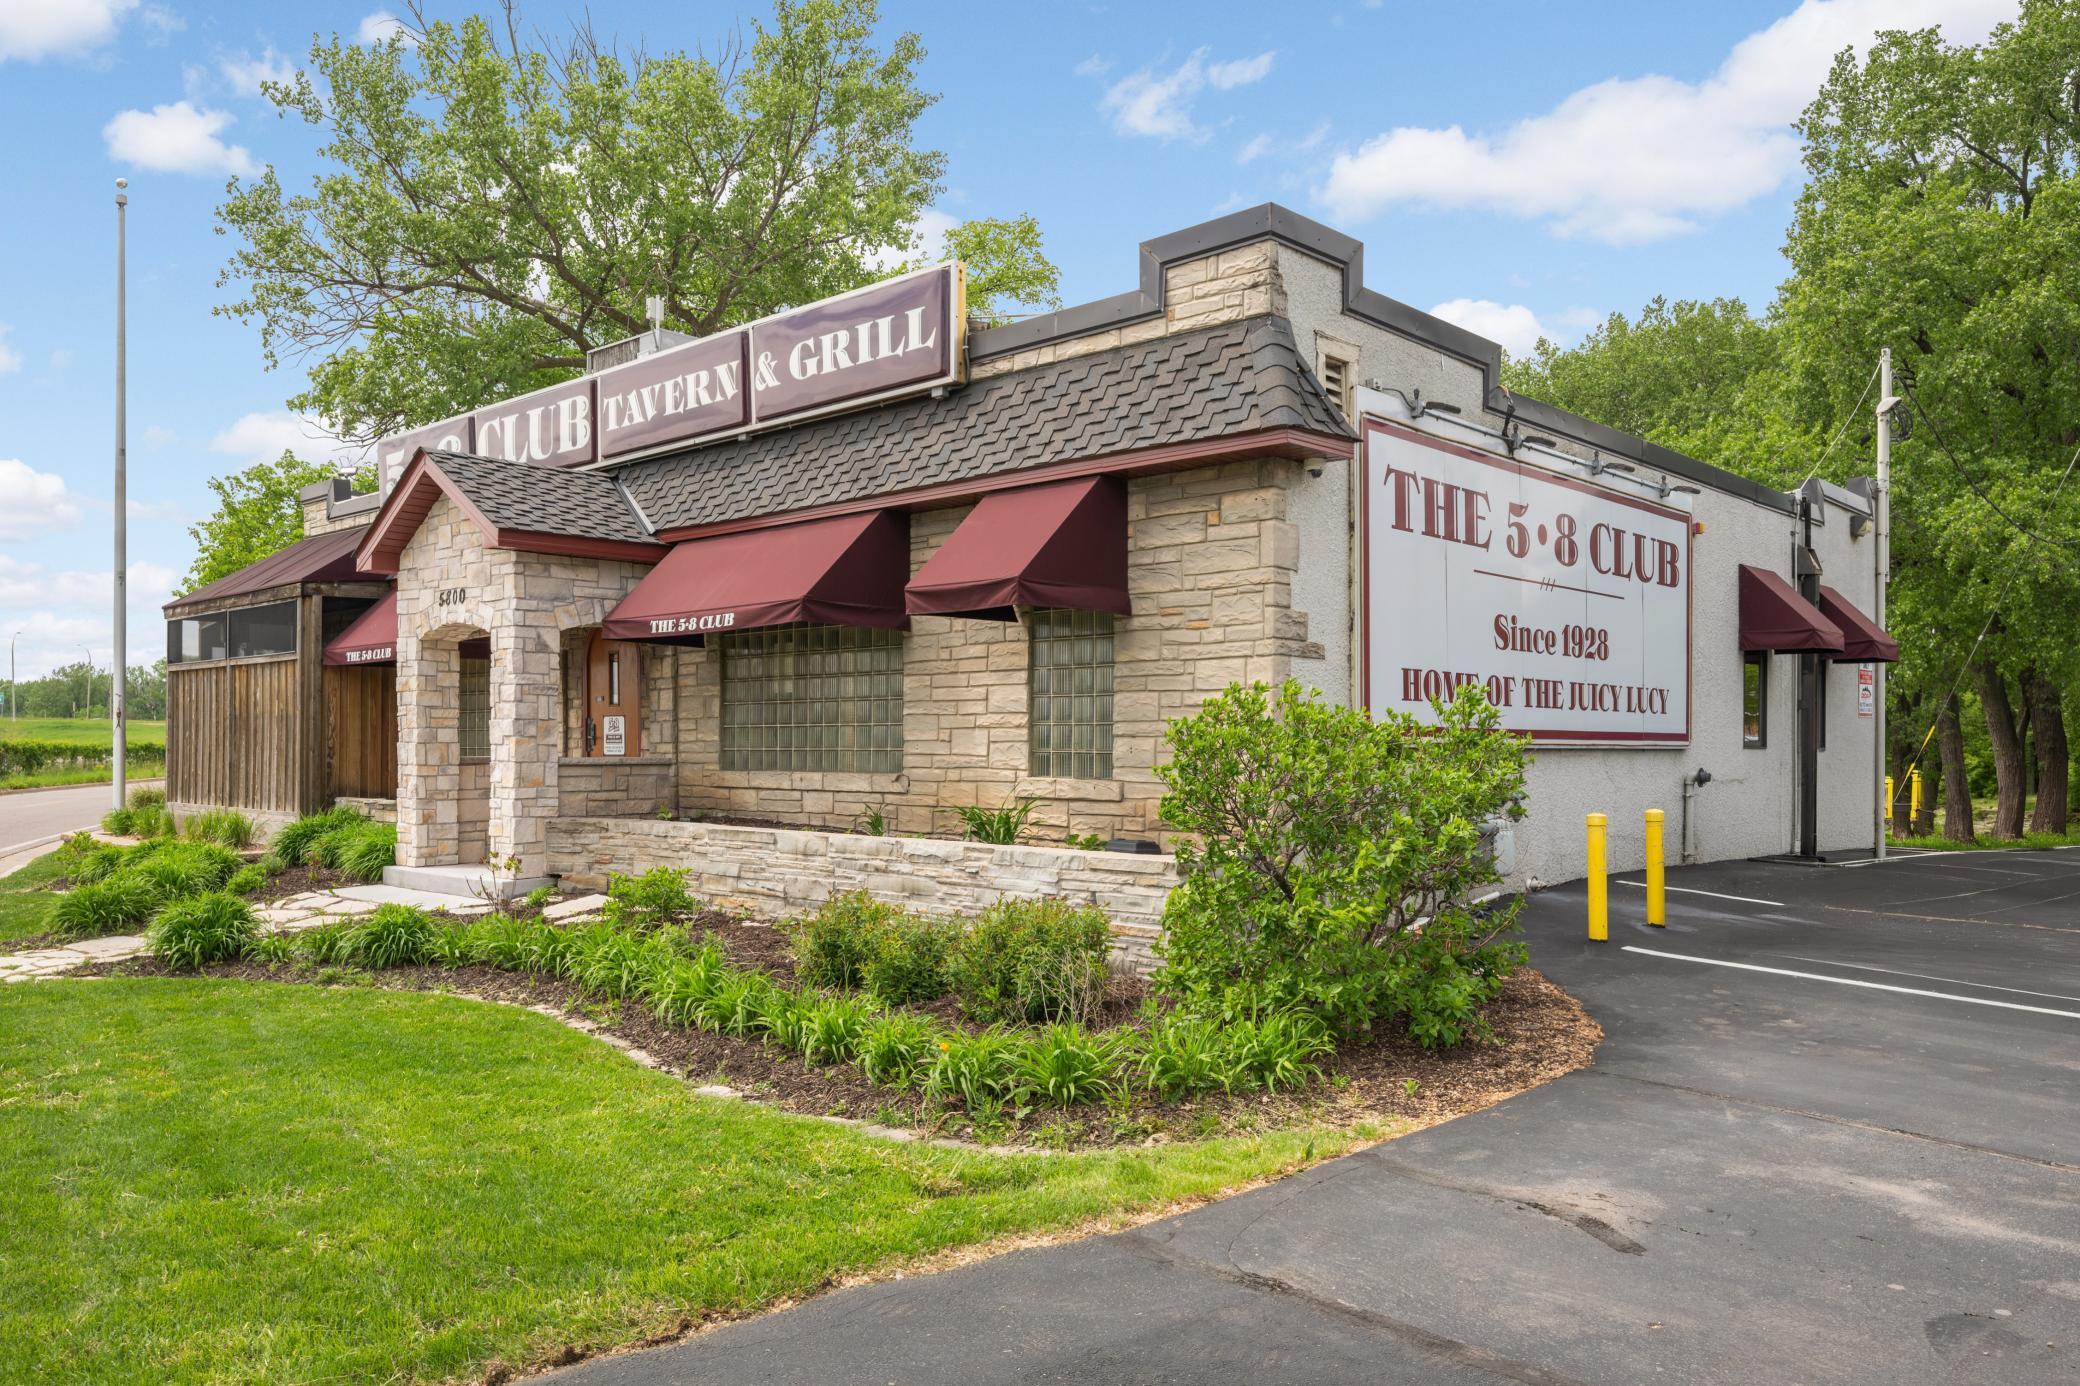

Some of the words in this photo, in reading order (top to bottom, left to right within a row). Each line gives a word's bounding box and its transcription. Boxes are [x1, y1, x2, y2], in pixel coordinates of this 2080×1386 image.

[478, 394, 591, 462] CLUB
[603, 360, 740, 432] TAVERN
[755, 351, 782, 391] &
[789, 306, 936, 381] GRILL
[1384, 464, 1492, 552] THE
[1589, 522, 1680, 588] CLUB
[439, 588, 466, 607] 5800
[649, 619, 677, 633] THE
[699, 613, 735, 629] CLUB
[1494, 614, 1557, 655] Since
[1562, 624, 1610, 660] 1928
[346, 651, 361, 662] THE
[373, 648, 391, 658] CLUB
[1486, 675, 1517, 707] OF
[1522, 677, 1564, 709] THE
[1568, 681, 1623, 713] JUICY
[1626, 686, 1670, 715] LUCY
